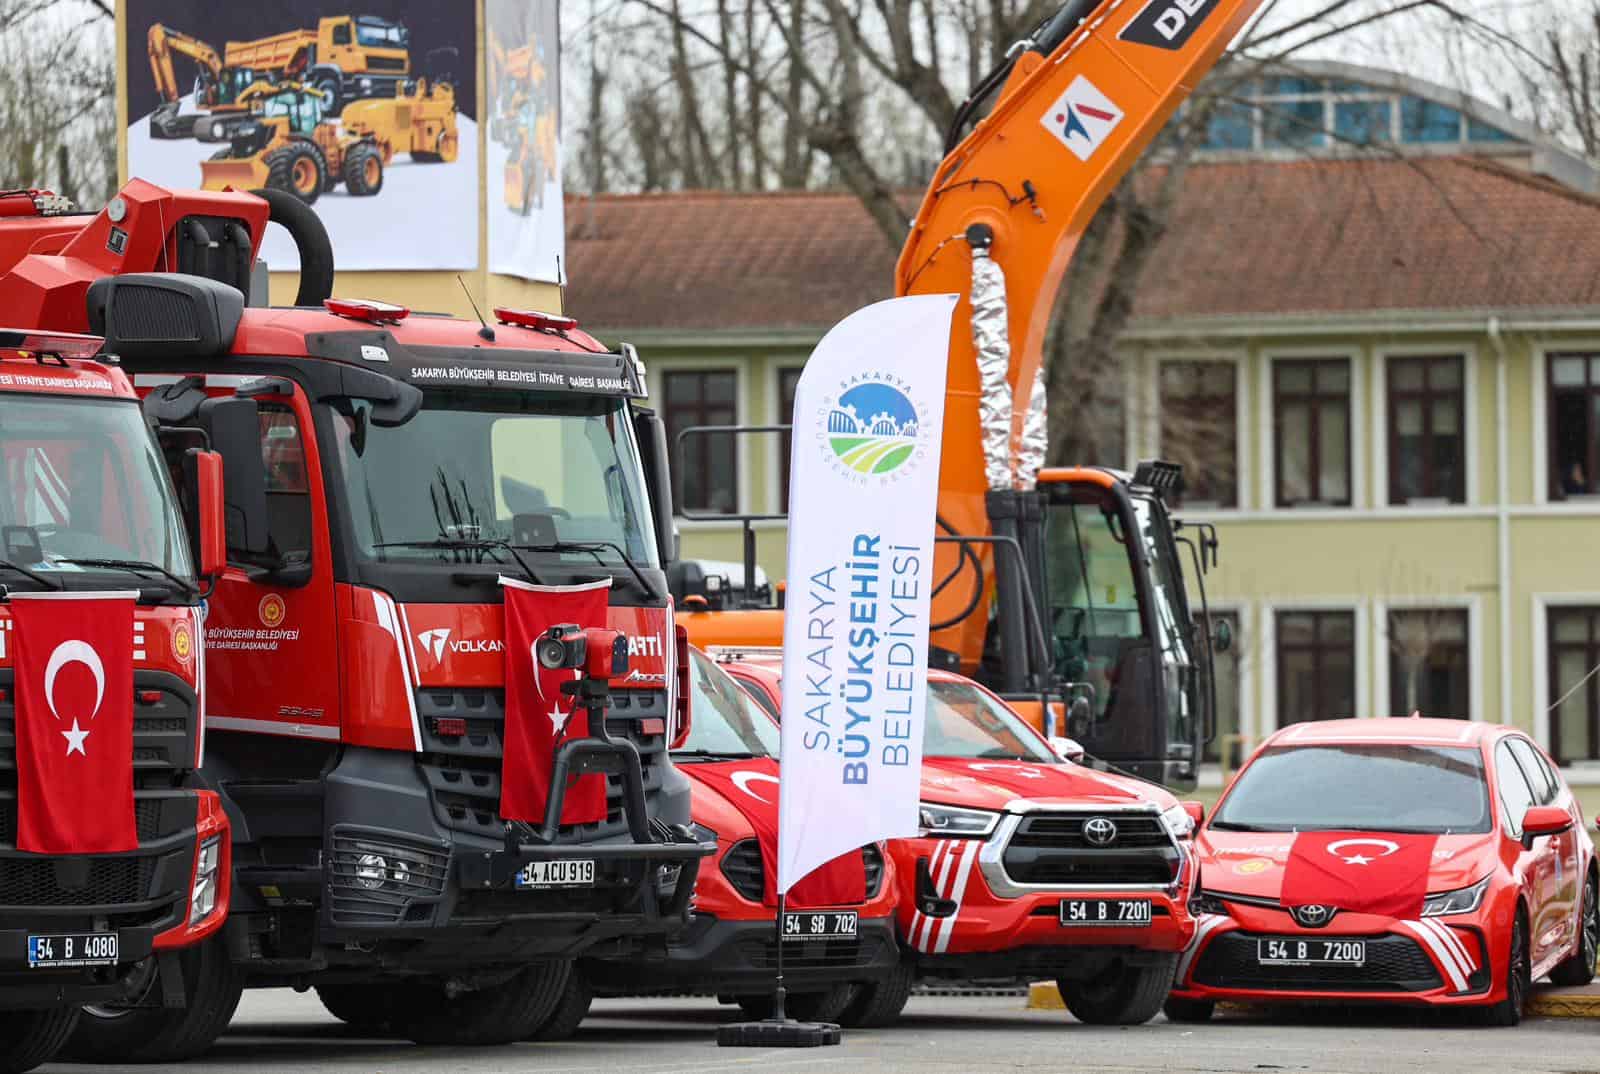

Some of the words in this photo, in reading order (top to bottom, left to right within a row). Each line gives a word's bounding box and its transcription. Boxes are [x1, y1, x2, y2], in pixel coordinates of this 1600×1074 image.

[411, 367, 447, 379] SAKARYA
[497, 369, 537, 383] BELEDİYESİ
[539, 370, 564, 385] İTFAİYE
[839, 371, 912, 394] SAKARYA
[255, 628, 299, 641] BELEDİYESİ
[803, 566, 837, 751] SAKARYA
[838, 533, 881, 785] BÜYÜKŞEHİR
[882, 545, 921, 766] BELEDİYESİ
[523, 863, 537, 882] 54
[543, 863, 566, 882] ACU
[570, 862, 592, 881] 919
[1069, 902, 1086, 920] 54
[1098, 902, 1107, 920] B
[1118, 902, 1148, 920] 7201
[786, 915, 800, 933] 54
[811, 915, 825, 933] SB
[834, 915, 855, 933] 702
[37, 938, 53, 959] 54
[65, 937, 73, 959] B
[84, 936, 116, 957] 4080
[1268, 941, 1288, 959] 54
[1297, 941, 1307, 959] B
[1323, 942, 1361, 961] 7200
